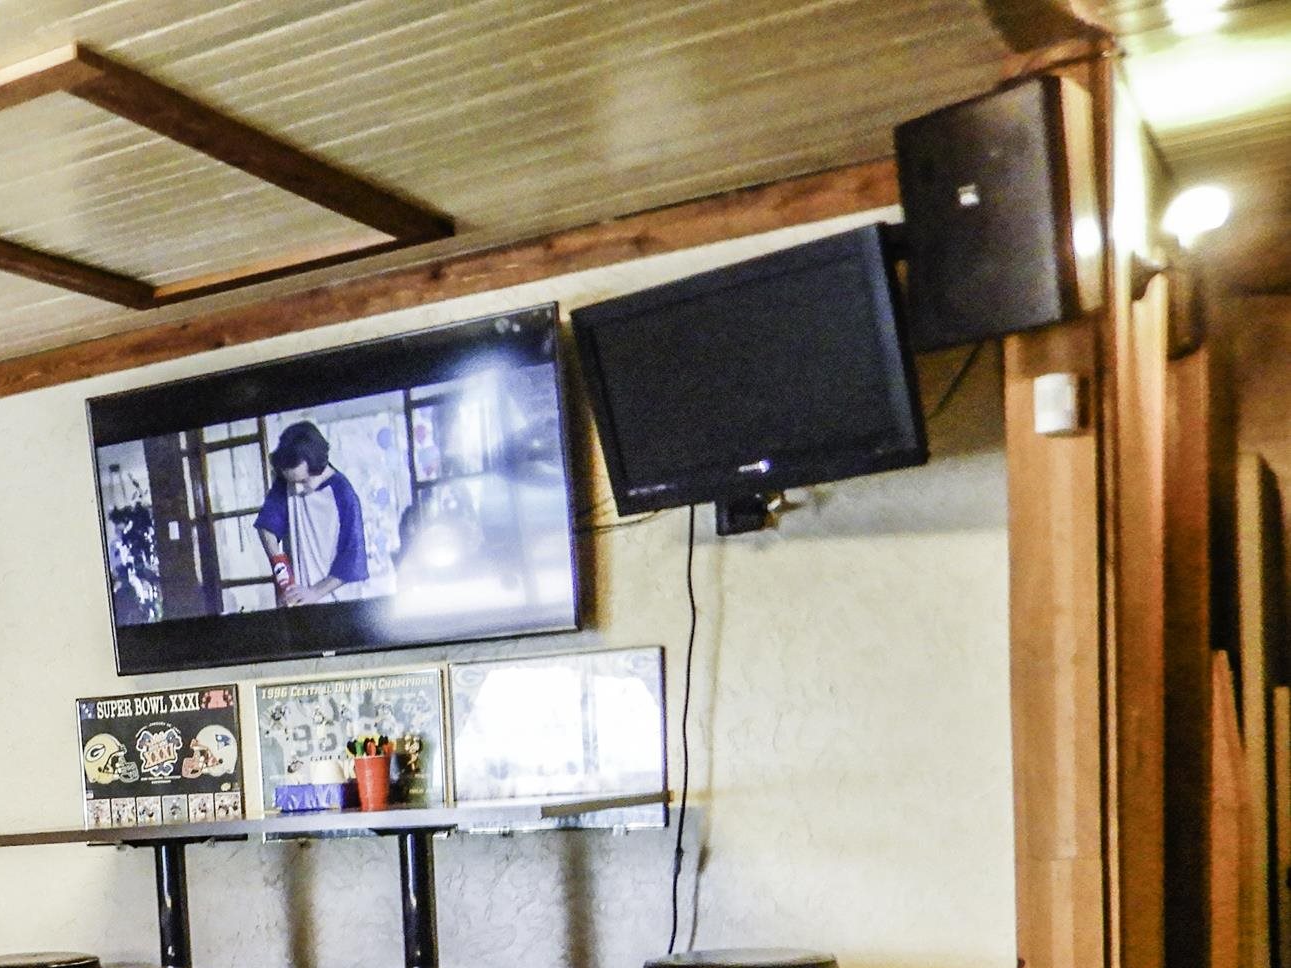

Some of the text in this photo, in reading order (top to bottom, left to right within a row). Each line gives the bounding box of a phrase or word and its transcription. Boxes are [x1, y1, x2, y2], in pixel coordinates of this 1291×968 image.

[261, 686, 289, 700] 1996
[96, 692, 200, 719] SUPER BOWL XXXI
